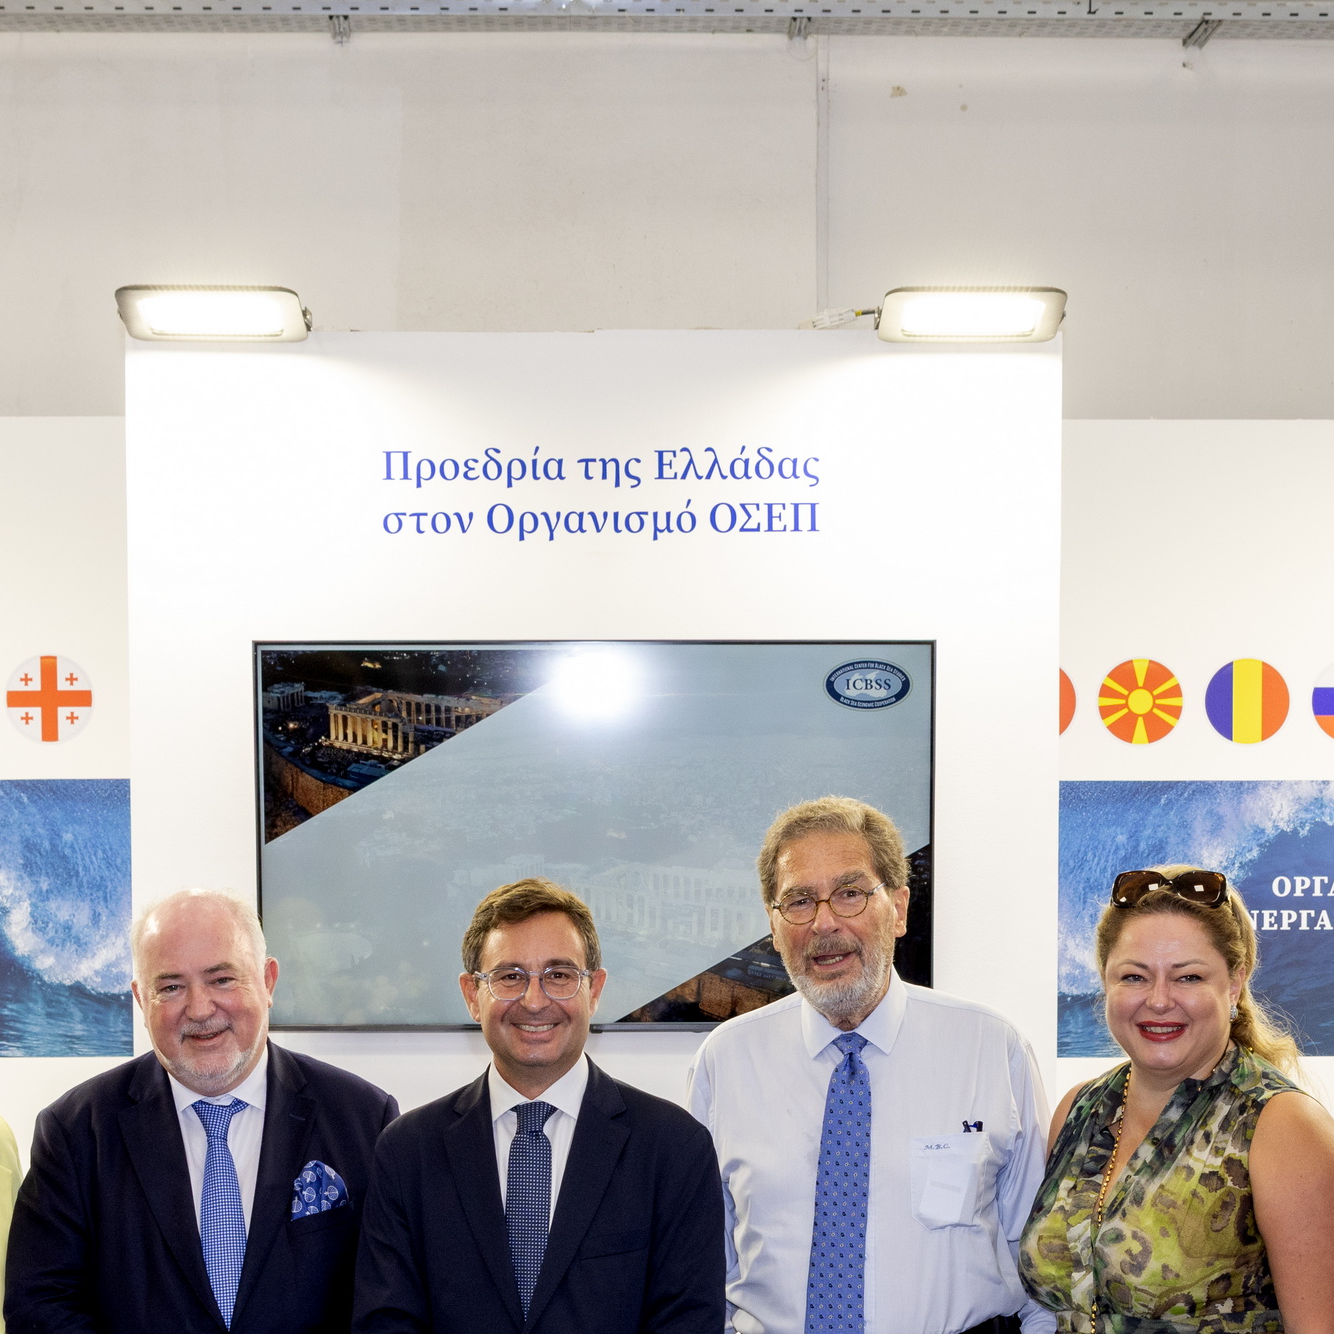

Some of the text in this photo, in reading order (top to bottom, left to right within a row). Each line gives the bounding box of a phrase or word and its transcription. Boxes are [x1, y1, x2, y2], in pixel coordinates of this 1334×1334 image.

[382, 445, 820, 488] Προεδρία της Ελλάδας
[382, 499, 820, 541] στον Οργανισμό ΟΣΕΠ
[845, 678, 892, 690] ICBSS
